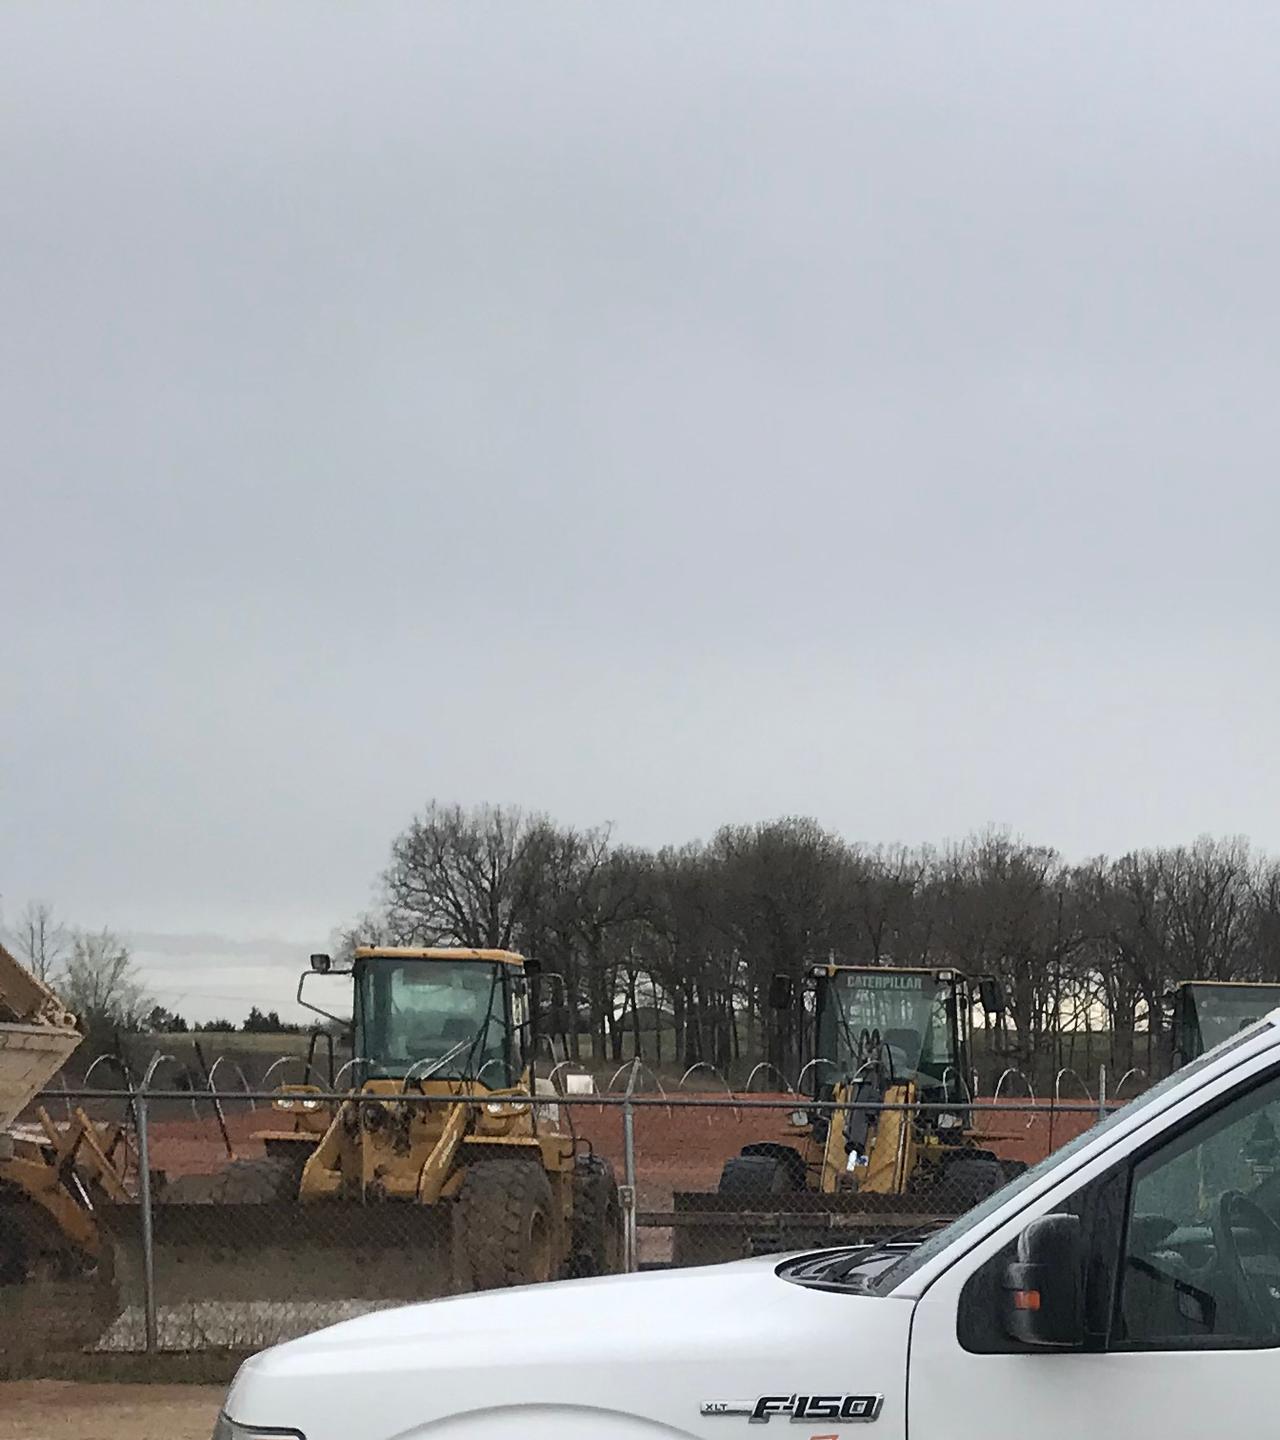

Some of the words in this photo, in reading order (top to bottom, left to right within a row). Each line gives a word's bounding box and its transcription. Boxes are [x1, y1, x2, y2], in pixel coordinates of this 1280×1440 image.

[847, 975, 922, 989] CATERPILLAR
[705, 1403, 728, 1411] XLT
[750, 1393, 883, 1423] F-150
